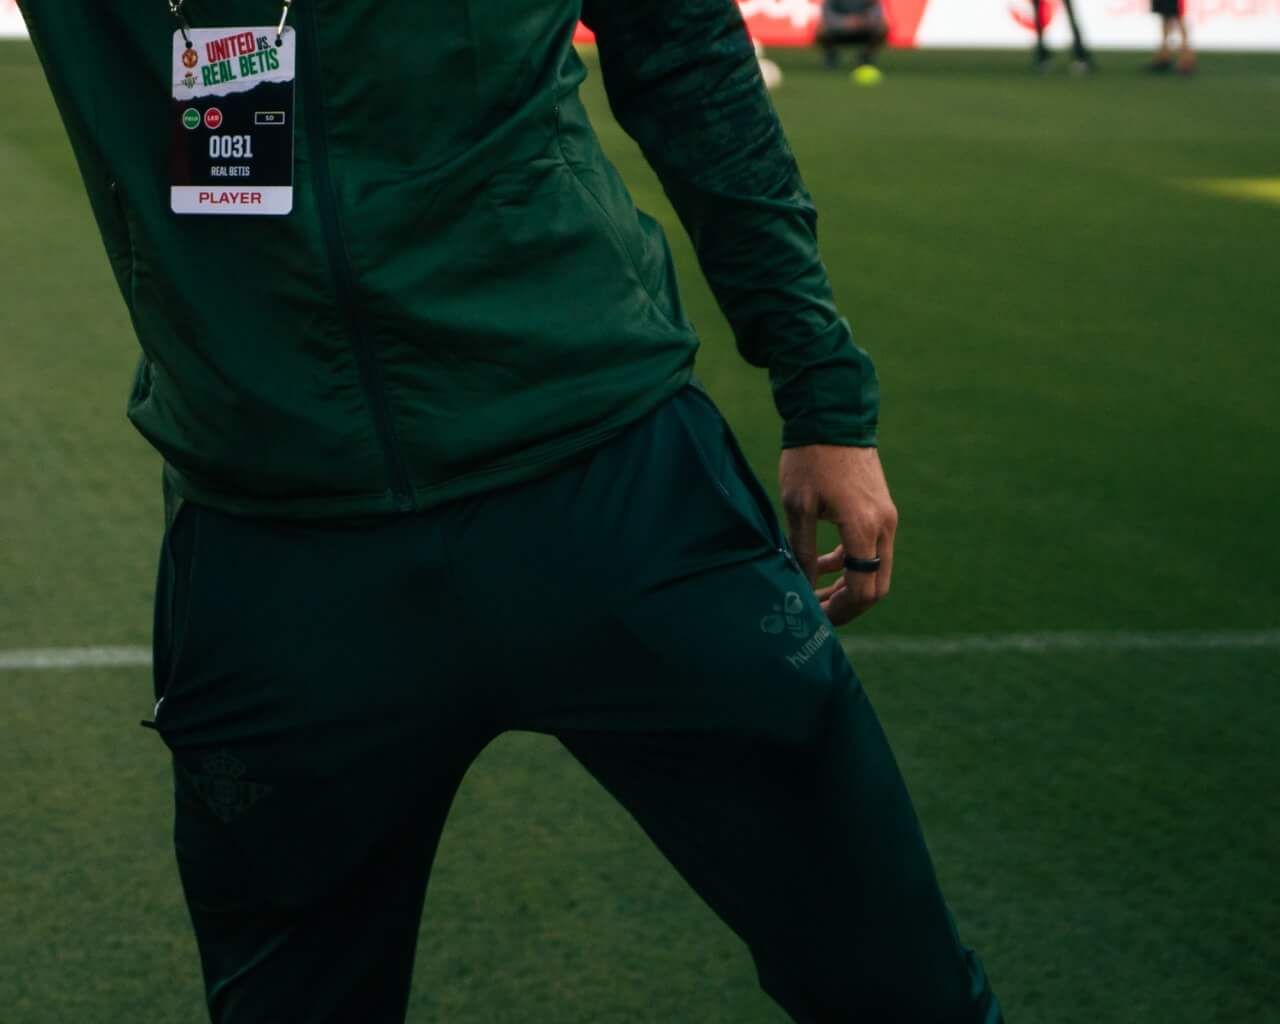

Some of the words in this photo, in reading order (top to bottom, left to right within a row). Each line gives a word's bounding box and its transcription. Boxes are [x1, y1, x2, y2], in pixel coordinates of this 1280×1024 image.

[206, 31, 255, 63] UNITED
[201, 57, 237, 87] REAL
[240, 47, 280, 77] BETIS
[209, 135, 253, 158] 0031
[211, 166, 228, 177] REAL
[229, 166, 250, 177] BETIS
[199, 191, 262, 205] PLAYER
